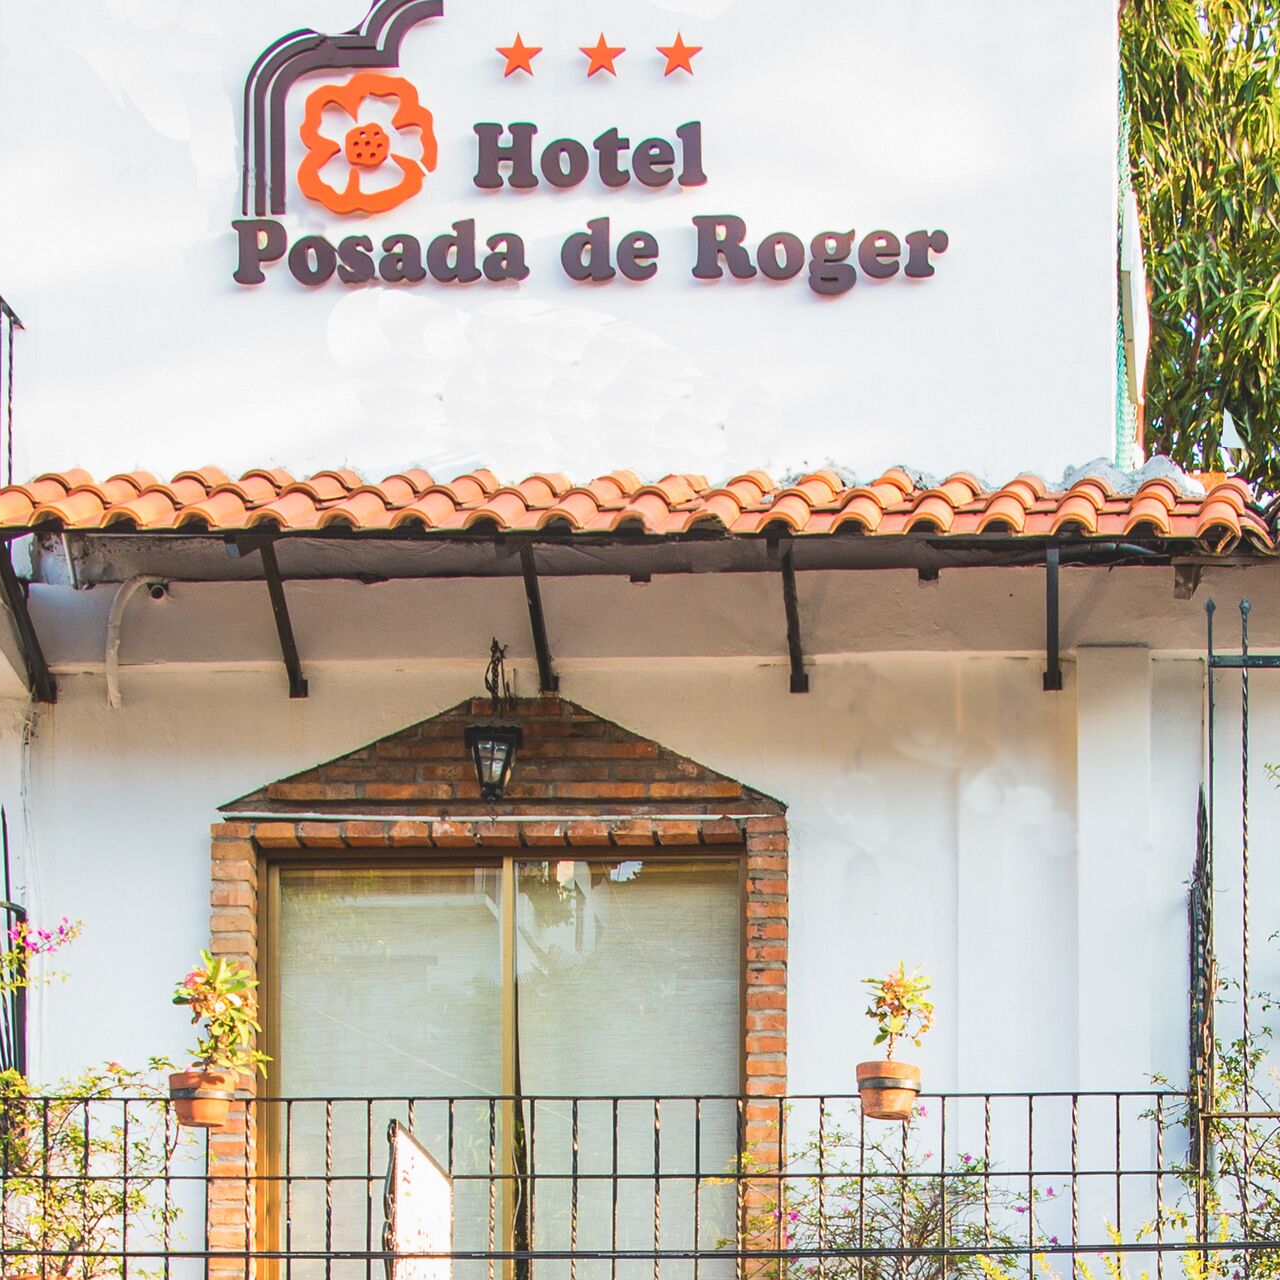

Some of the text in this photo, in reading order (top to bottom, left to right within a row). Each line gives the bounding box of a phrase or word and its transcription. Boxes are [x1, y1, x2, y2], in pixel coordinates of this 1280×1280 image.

[472, 121, 708, 190] Hotel
[231, 214, 949, 296] Posada de Roger
